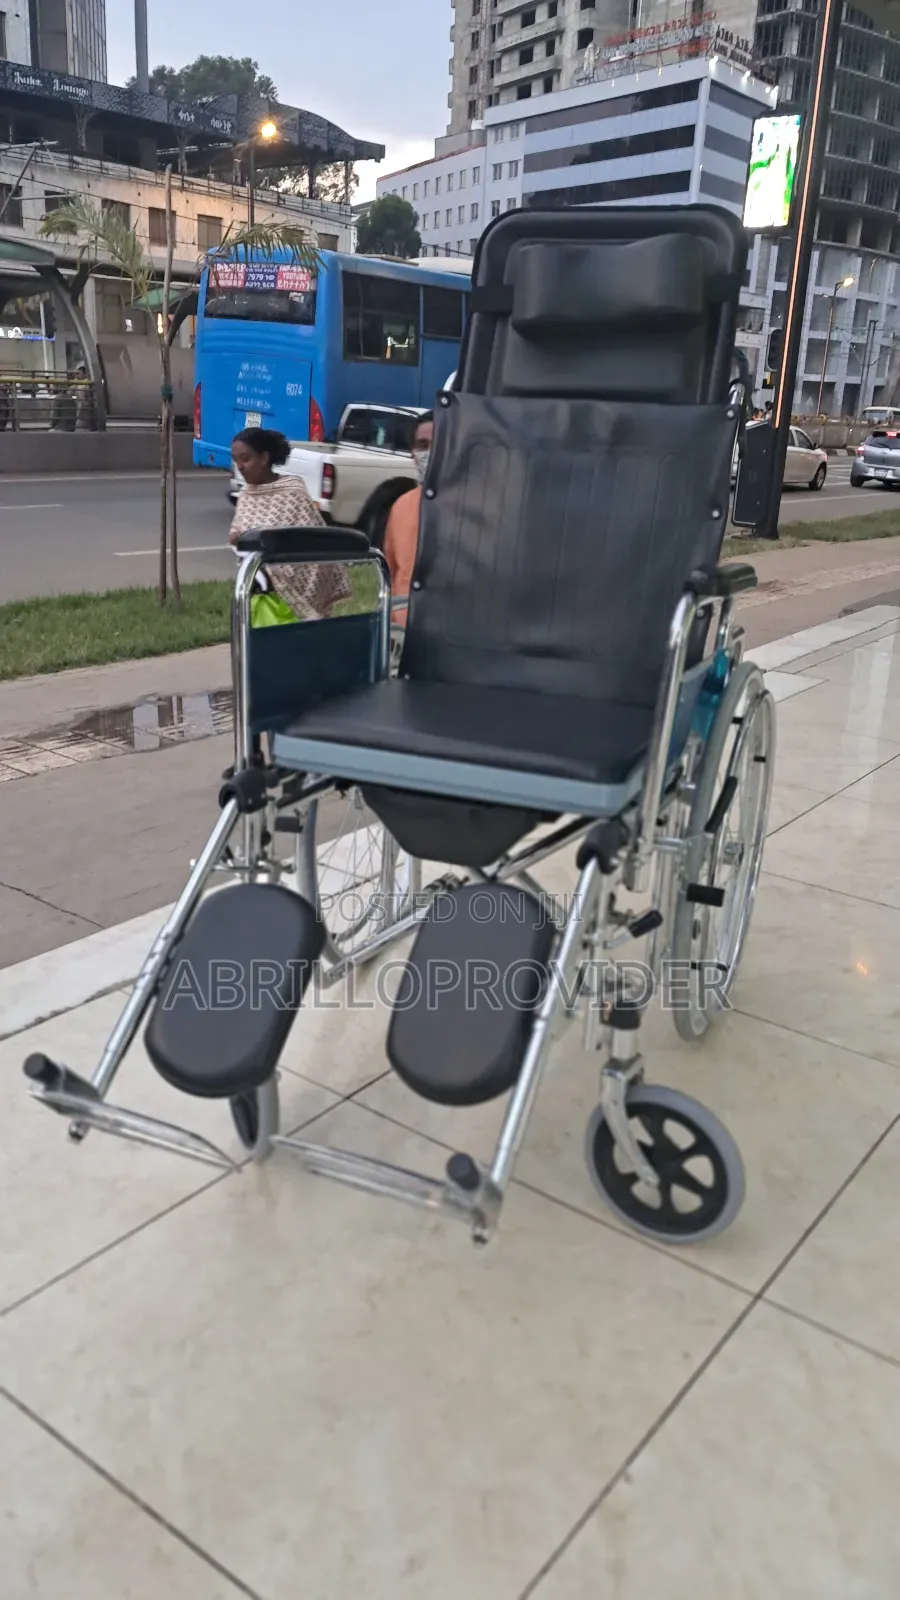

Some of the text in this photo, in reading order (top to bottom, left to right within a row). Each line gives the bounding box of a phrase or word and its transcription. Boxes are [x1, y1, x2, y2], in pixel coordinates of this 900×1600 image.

[53, 79, 89, 97] Lounge
[247, 273, 264, 281] 7979
[286, 383, 303, 396] 6074
